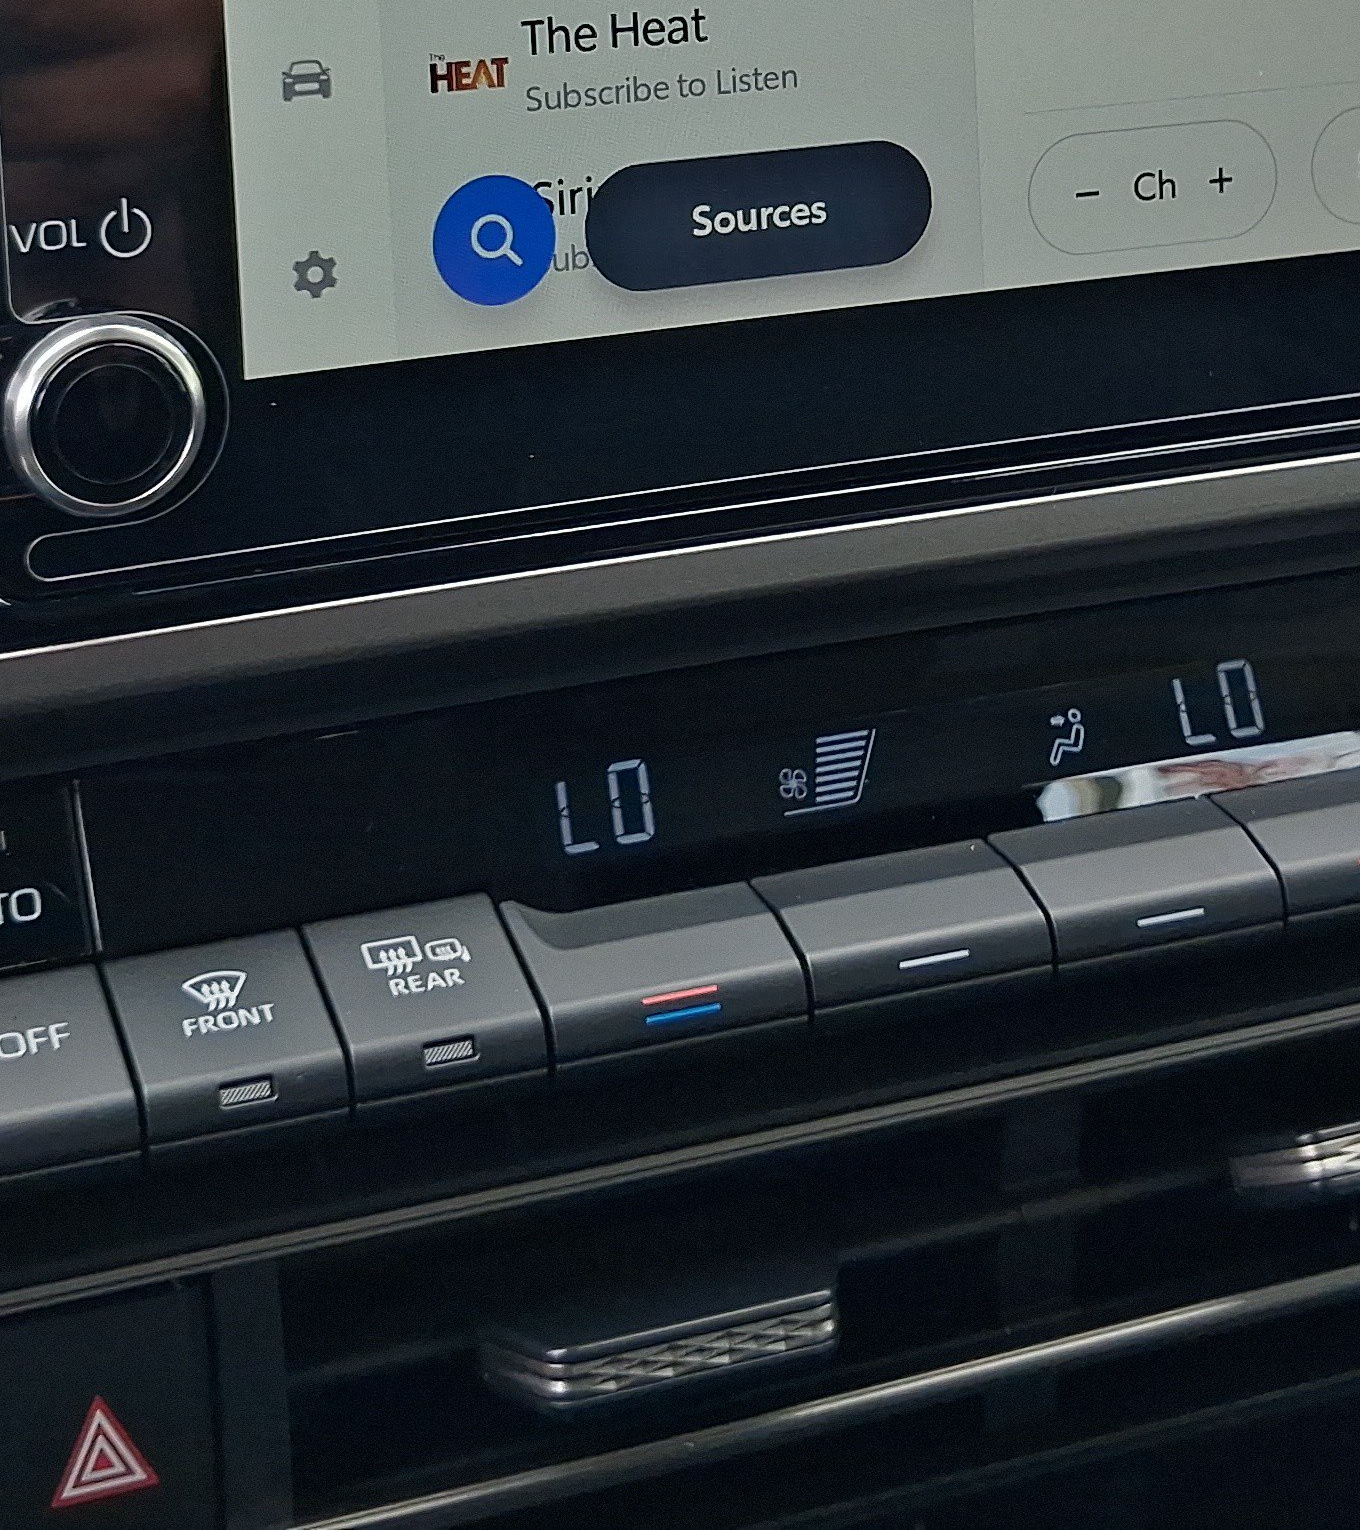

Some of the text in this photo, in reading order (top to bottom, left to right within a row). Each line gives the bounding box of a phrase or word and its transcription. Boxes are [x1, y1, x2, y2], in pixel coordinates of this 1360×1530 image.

[521, 8, 709, 56] The Heat
[429, 57, 509, 93] HEAT
[526, 67, 799, 112] Subscribe to Listen
[533, 175, 594, 217] Siri
[1133, 169, 1177, 202] Ch
[9, 218, 87, 253] VOL
[691, 202, 828, 237] Sources
[388, 966, 466, 997] REAR
[181, 1002, 275, 1038] FRONT
